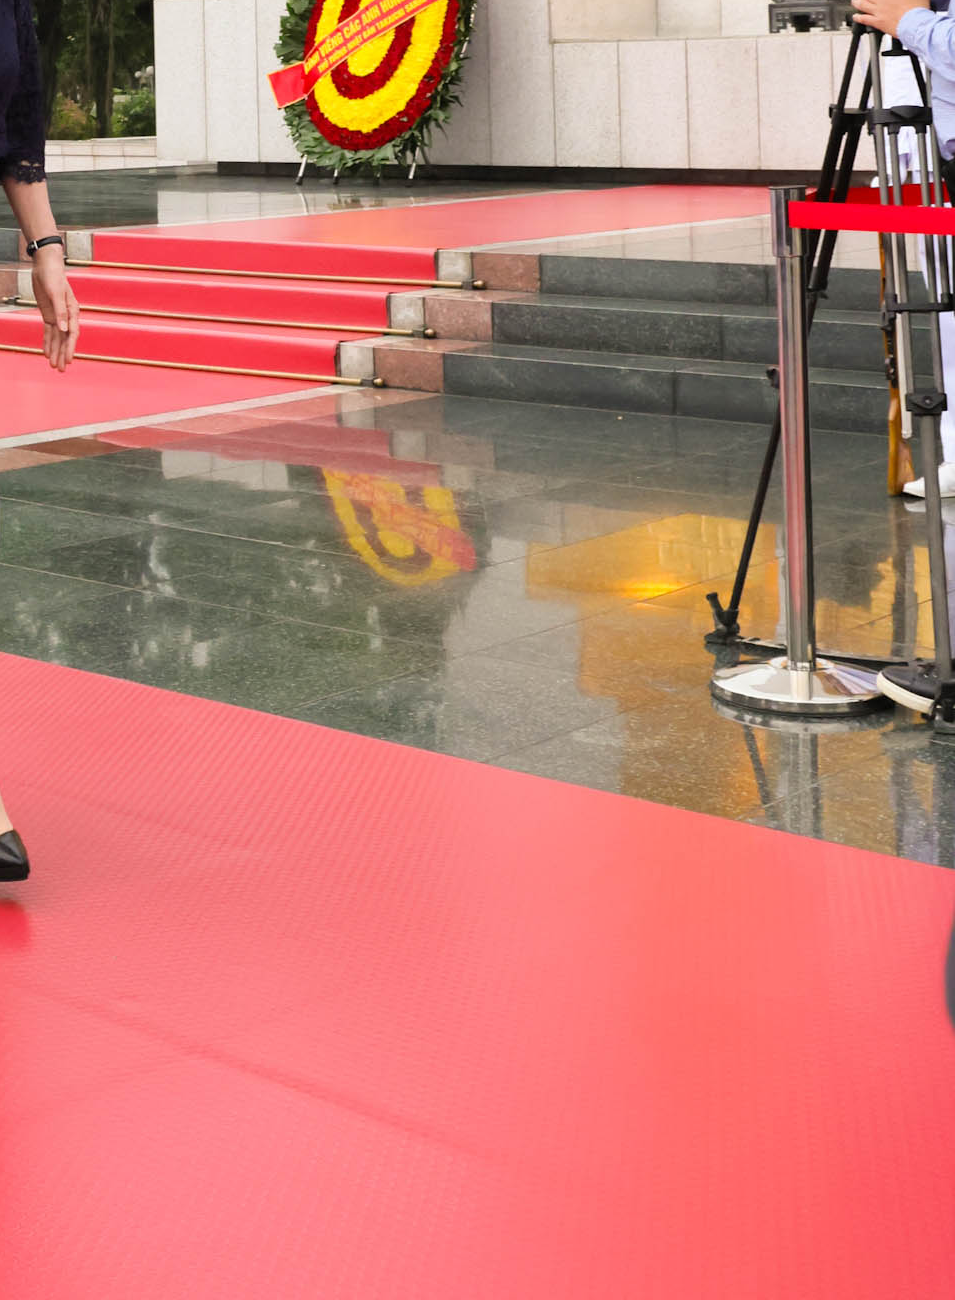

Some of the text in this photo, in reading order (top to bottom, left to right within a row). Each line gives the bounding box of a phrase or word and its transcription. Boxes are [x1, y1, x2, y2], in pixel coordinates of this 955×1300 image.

[319, 31, 344, 57] VIẾNG
[343, 19, 362, 39] CÁC
[361, 4, 381, 26] ANH
